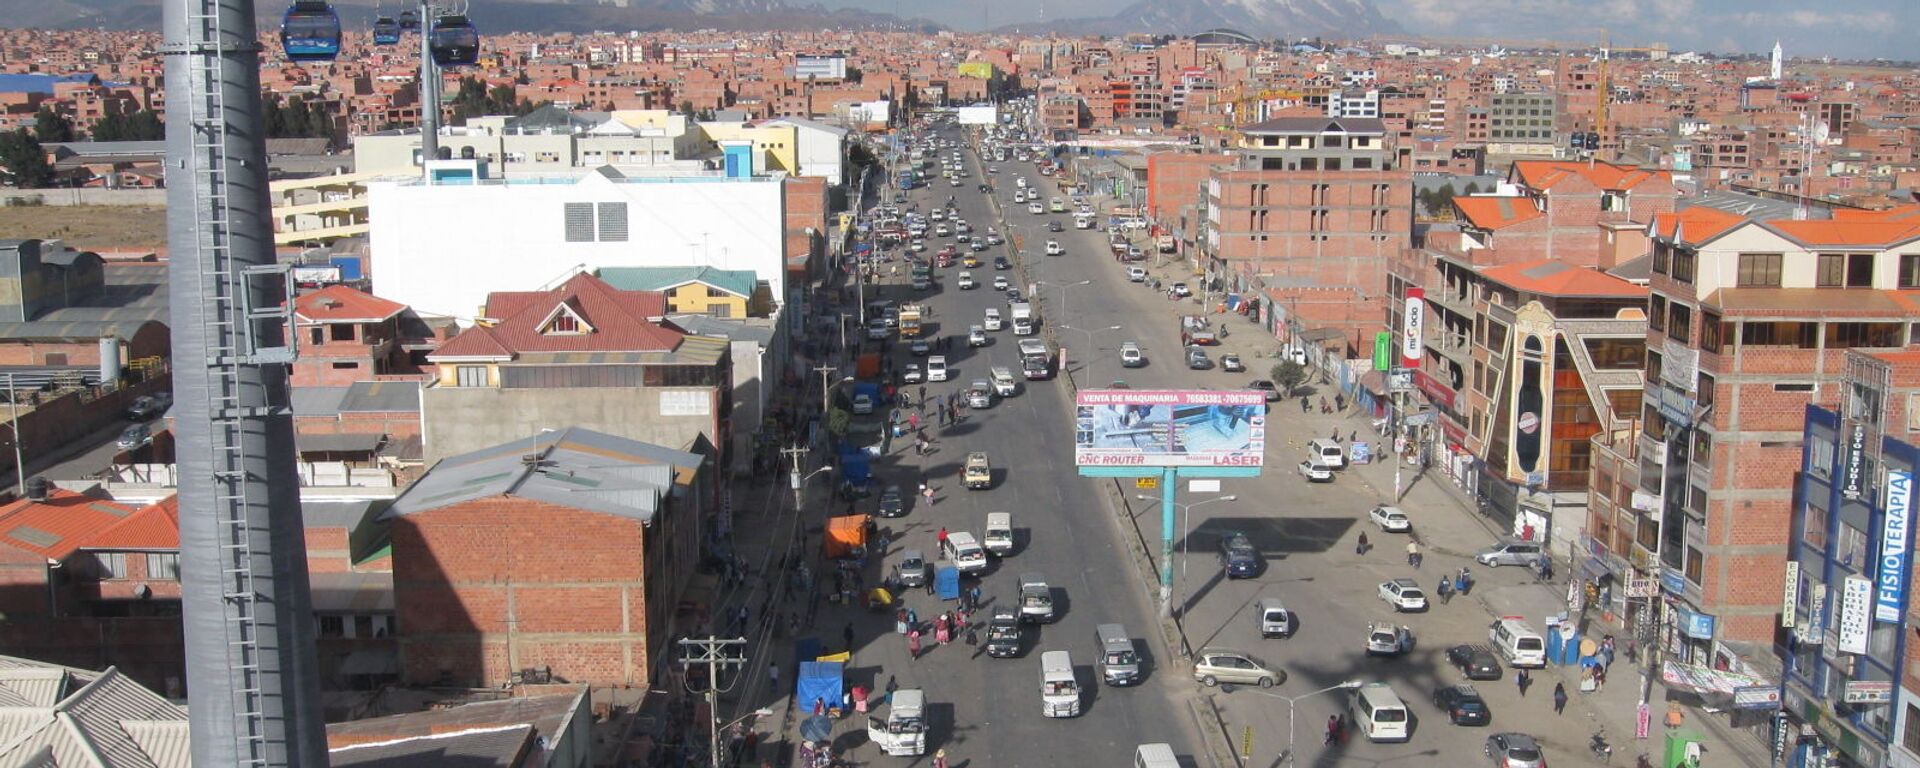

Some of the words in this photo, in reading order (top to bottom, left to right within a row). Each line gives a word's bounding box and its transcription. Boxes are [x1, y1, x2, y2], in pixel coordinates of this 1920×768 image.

[1083, 394, 1110, 403] VENTA
[1112, 394, 1123, 403] DE
[1124, 394, 1179, 403] MAQUINARIA
[1078, 455, 1100, 465] CNC
[1102, 455, 1145, 465] ROUTER
[1213, 456, 1261, 465] LASER
[1879, 472, 1908, 603] FISIOTERAPIA
